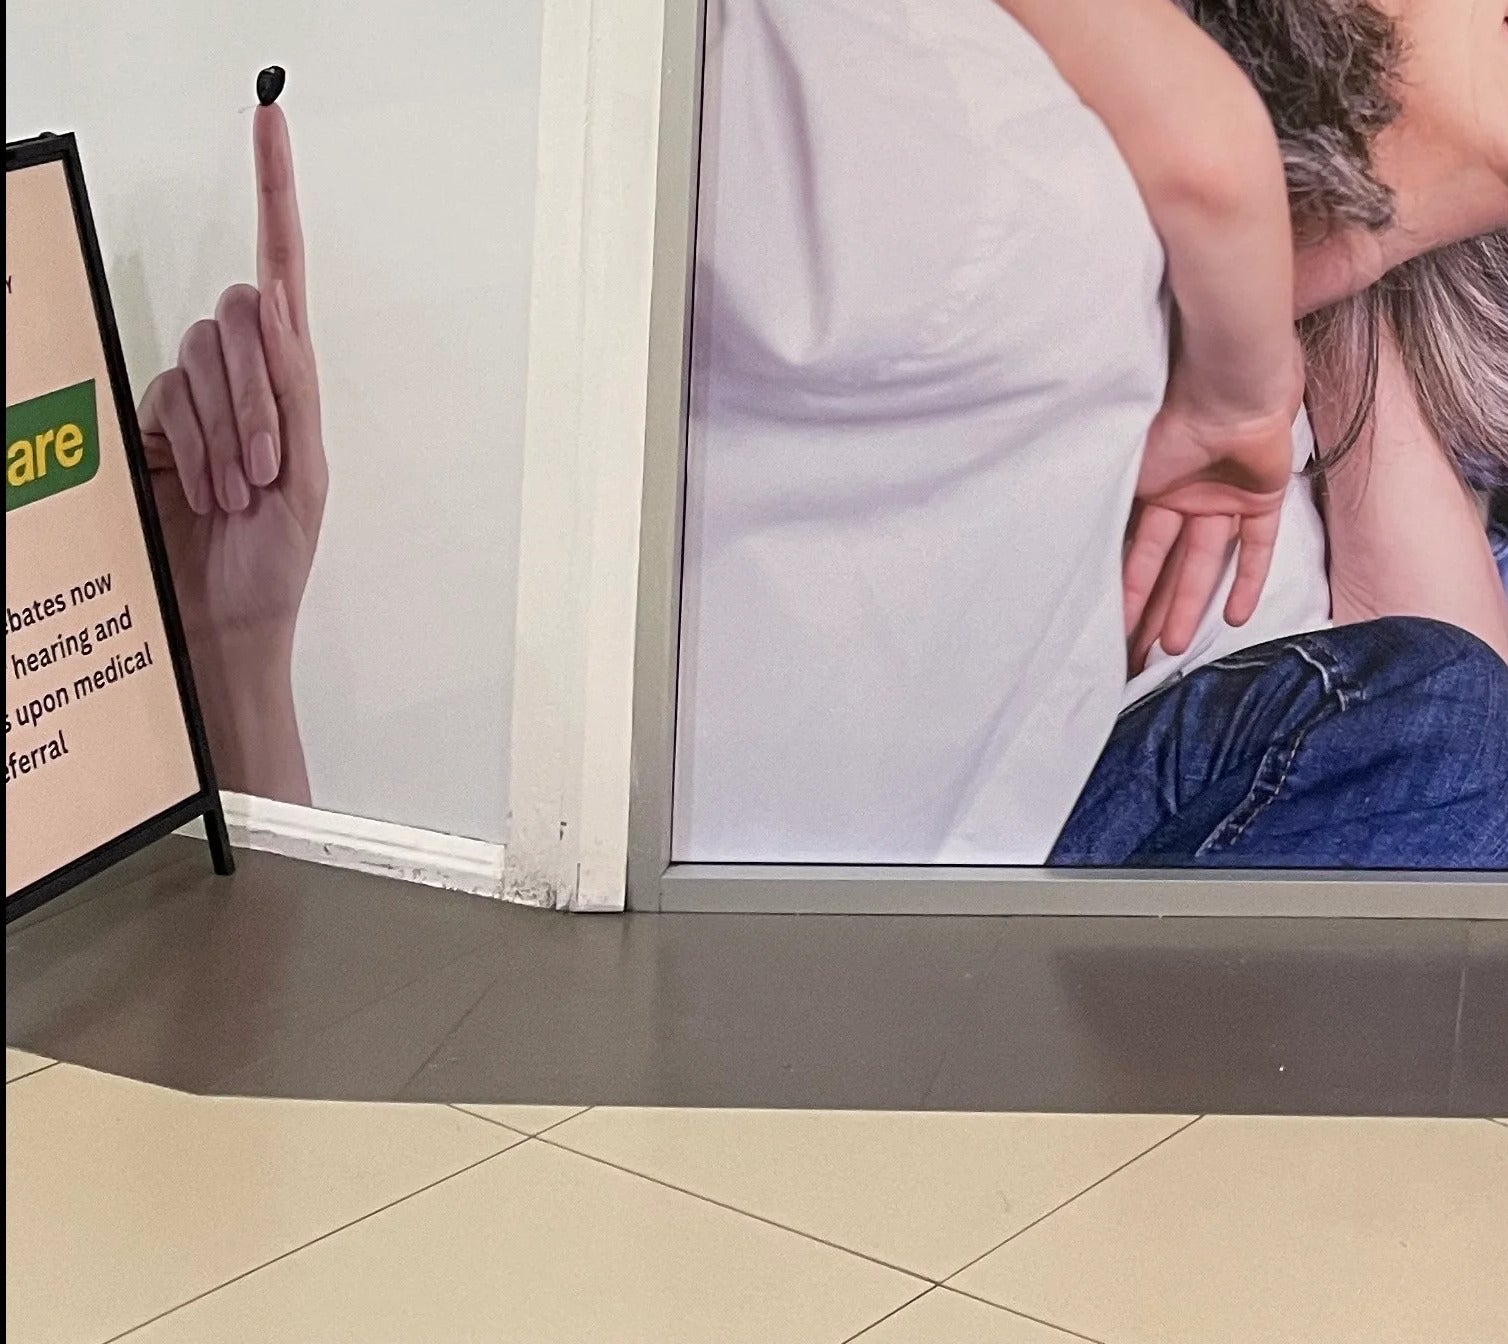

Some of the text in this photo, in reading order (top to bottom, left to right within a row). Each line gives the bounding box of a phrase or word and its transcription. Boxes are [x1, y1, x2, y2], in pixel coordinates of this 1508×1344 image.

[6, 573, 112, 637] bates now
[11, 604, 133, 680] hearing and
[15, 686, 70, 728] upon
[73, 641, 153, 700] medical
